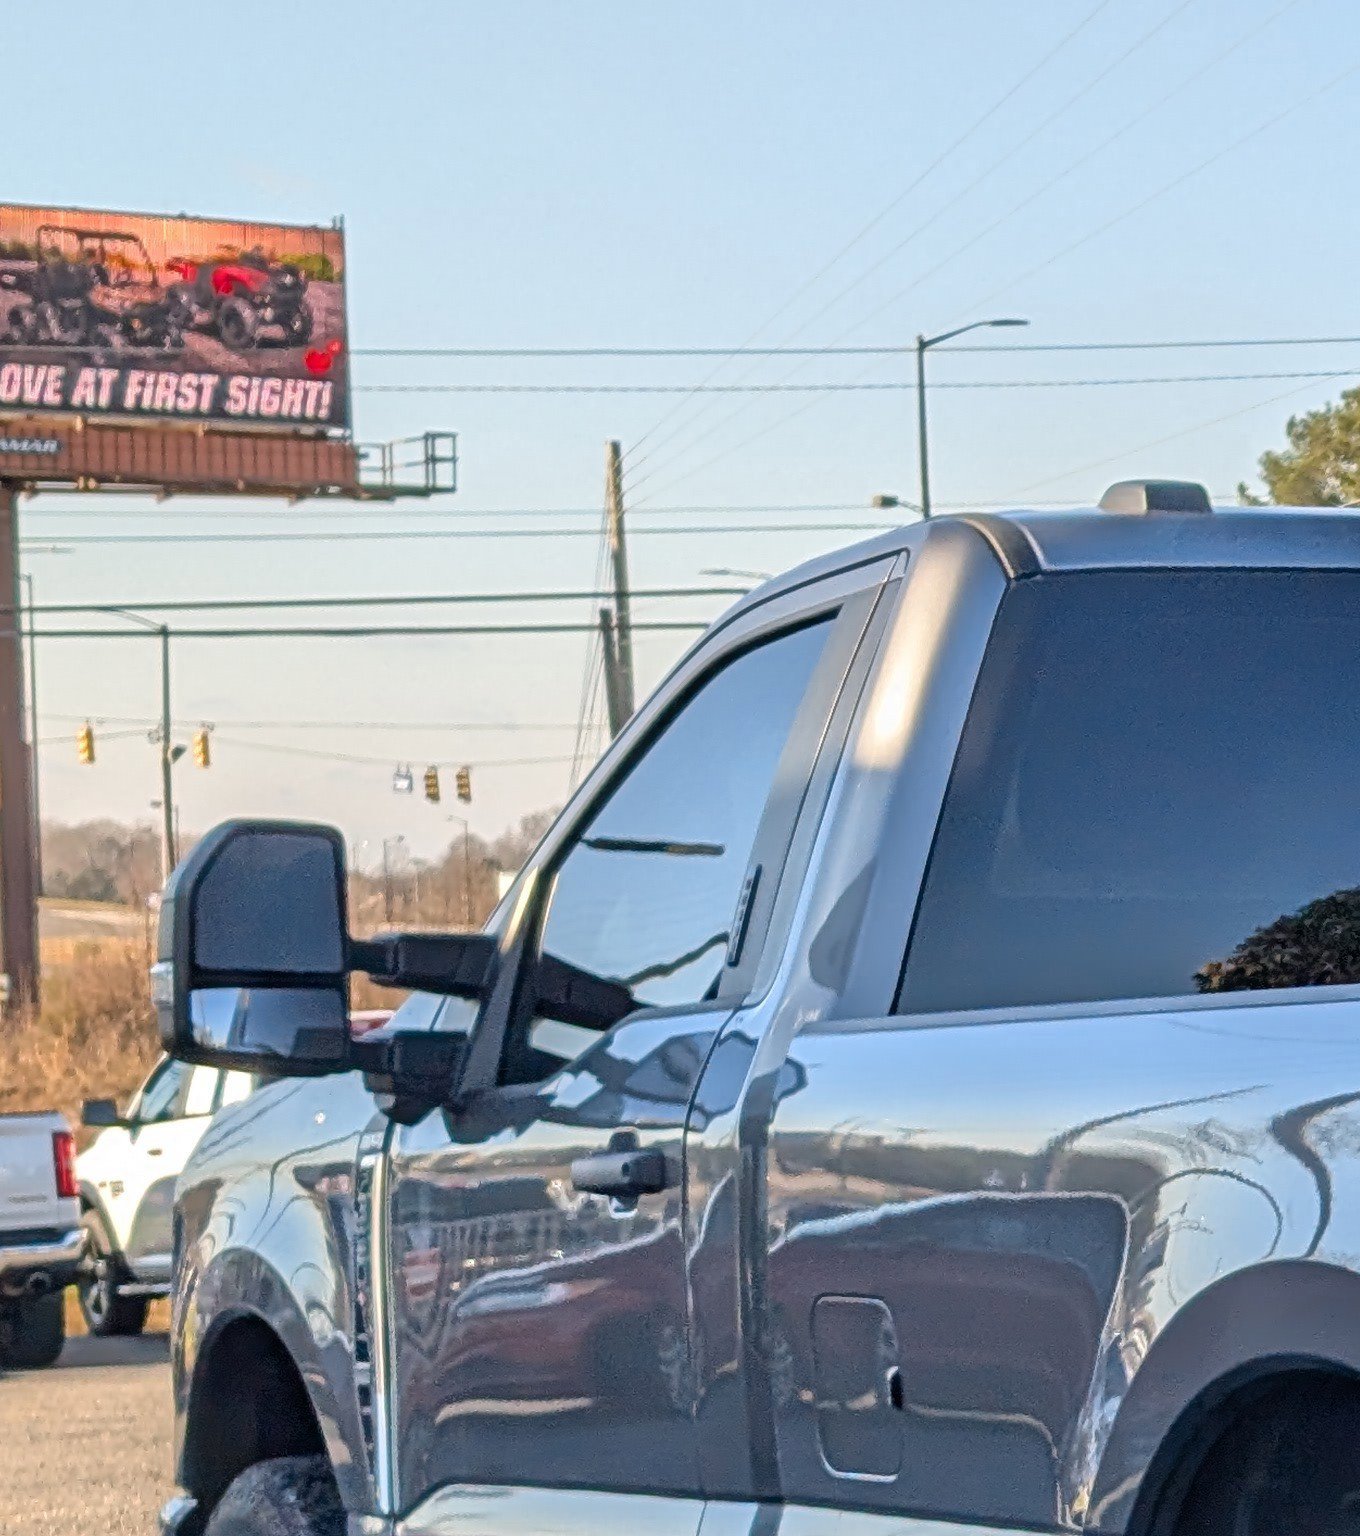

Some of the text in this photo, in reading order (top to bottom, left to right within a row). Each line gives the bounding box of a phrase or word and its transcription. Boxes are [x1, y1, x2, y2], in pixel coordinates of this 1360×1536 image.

[1, 363, 333, 418] OVE AT FIRST SIGHT!
